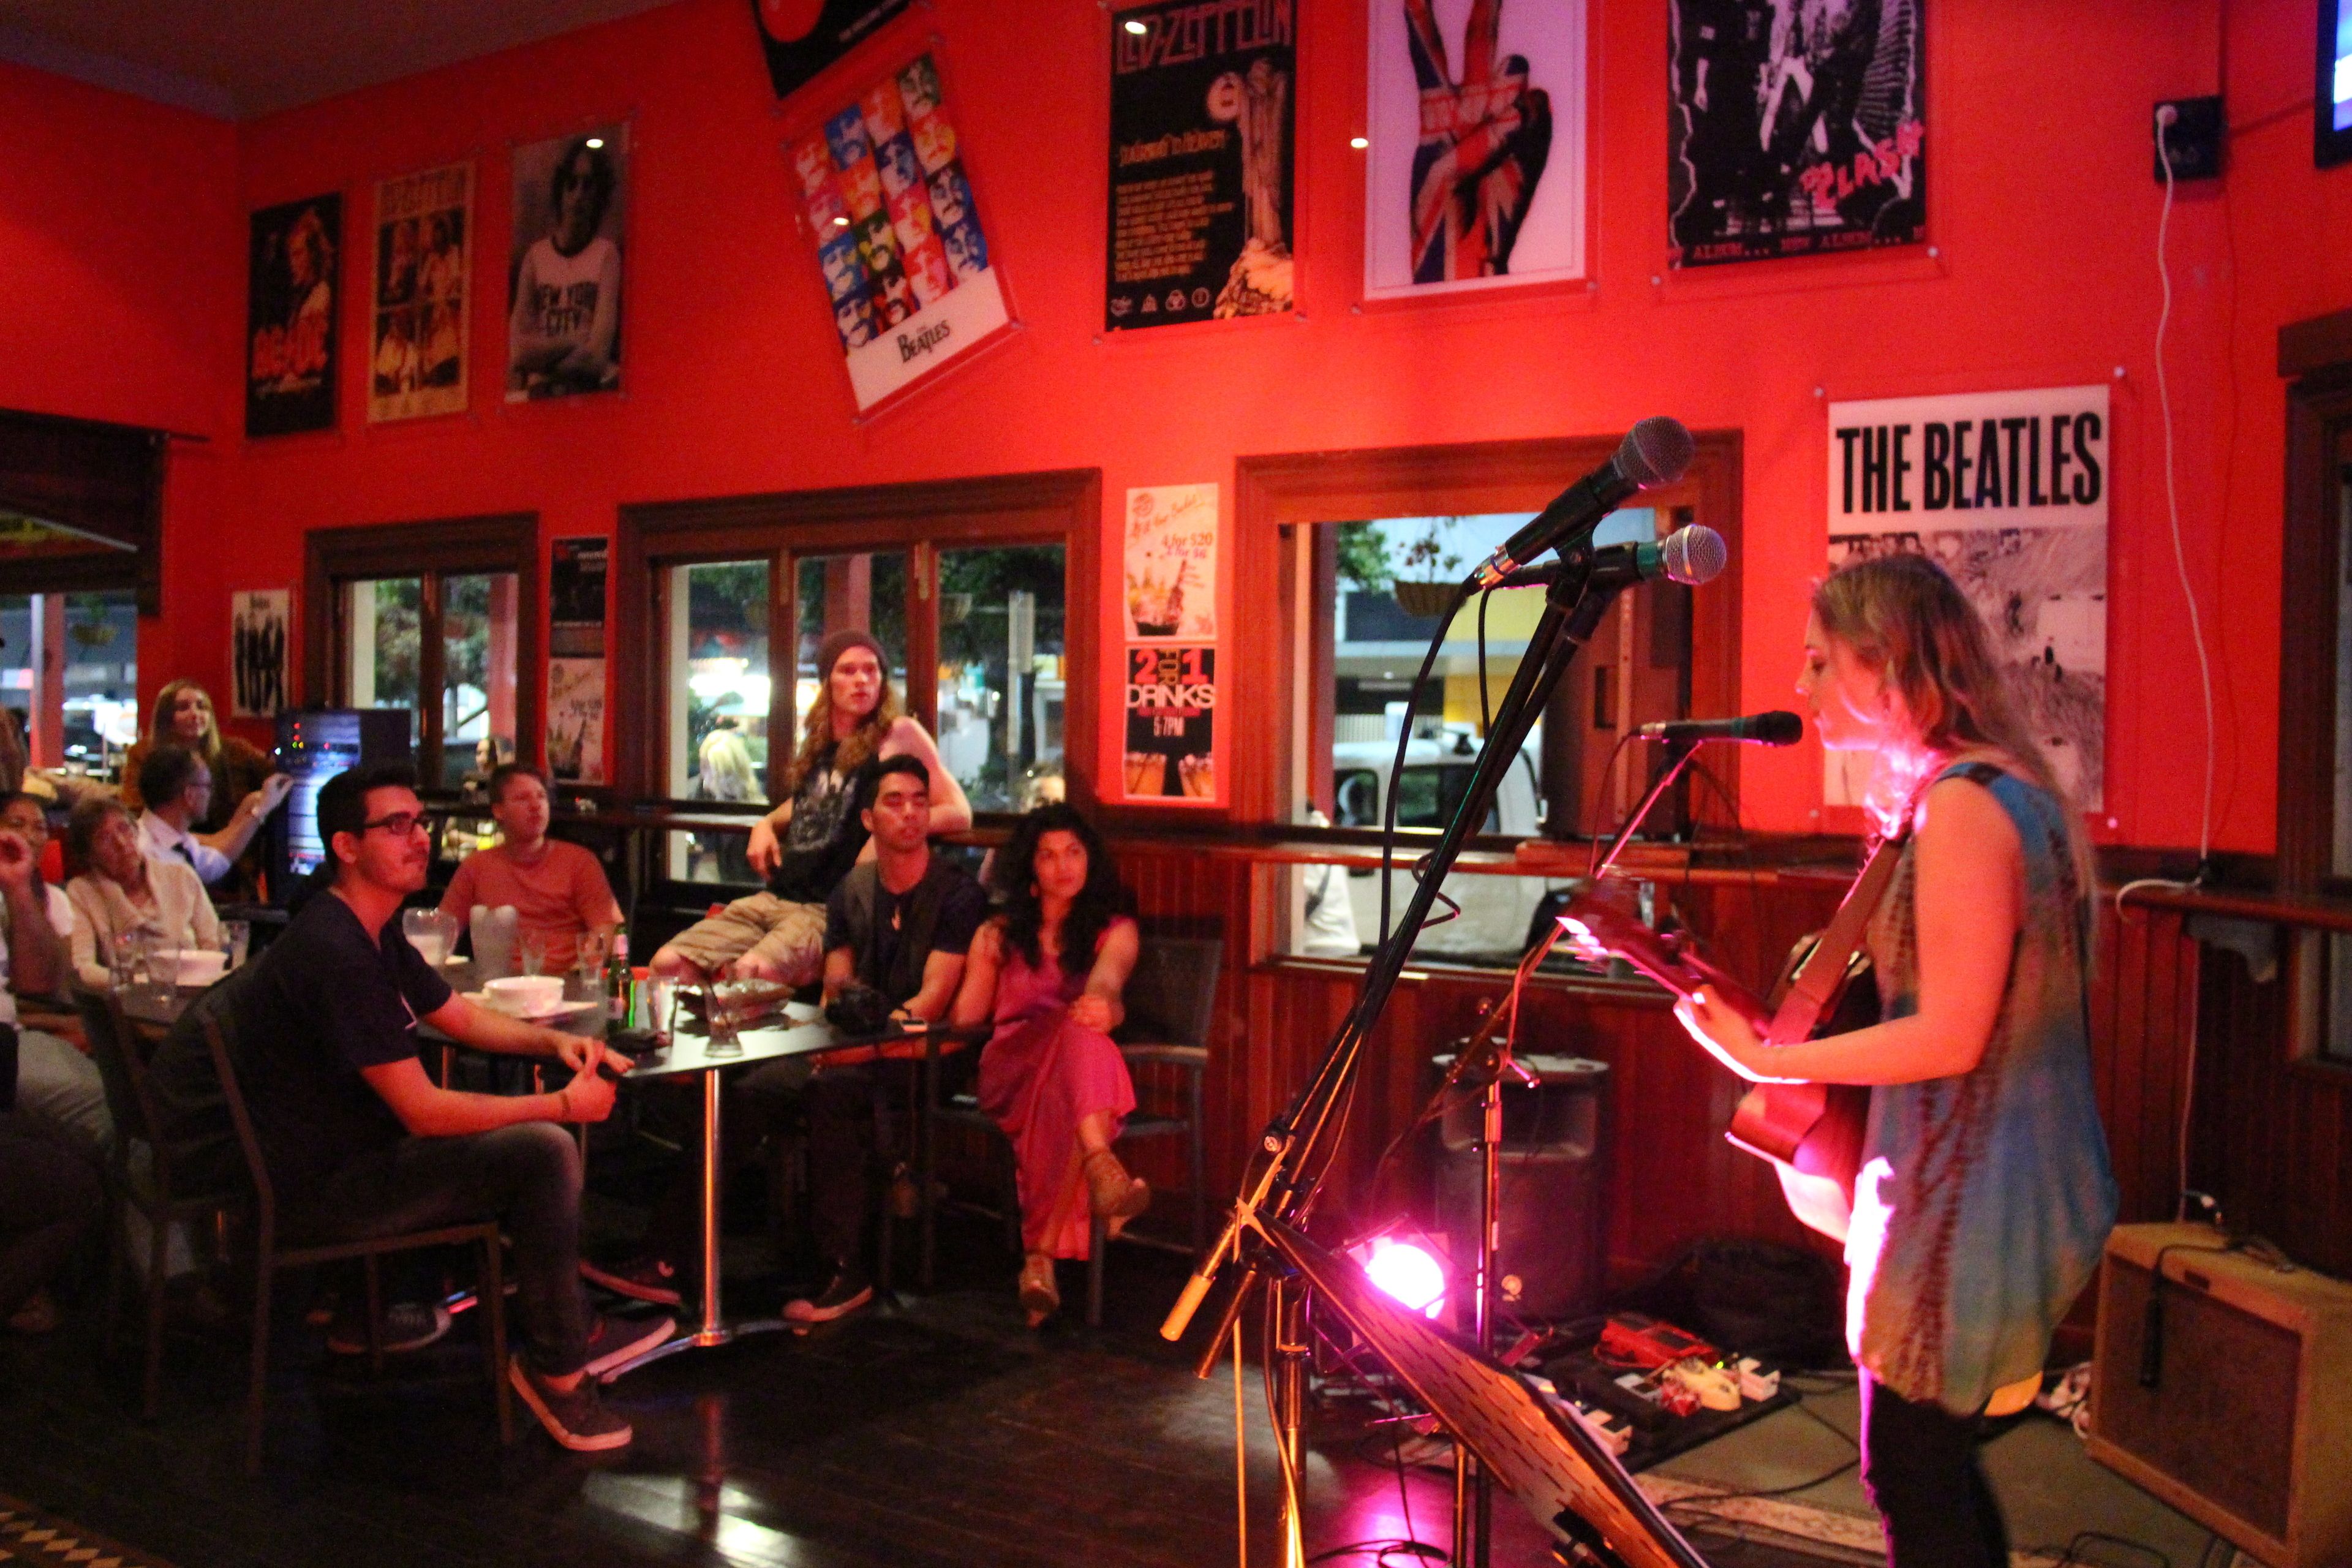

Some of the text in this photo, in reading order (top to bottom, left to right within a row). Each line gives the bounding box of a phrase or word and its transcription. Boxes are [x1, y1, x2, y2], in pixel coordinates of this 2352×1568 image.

[1836, 412, 2101, 513] THE BEATLES
[1134, 649, 1157, 684] 2
[1182, 648, 1208, 684] 1
[1127, 684, 1215, 709] DRINKS
